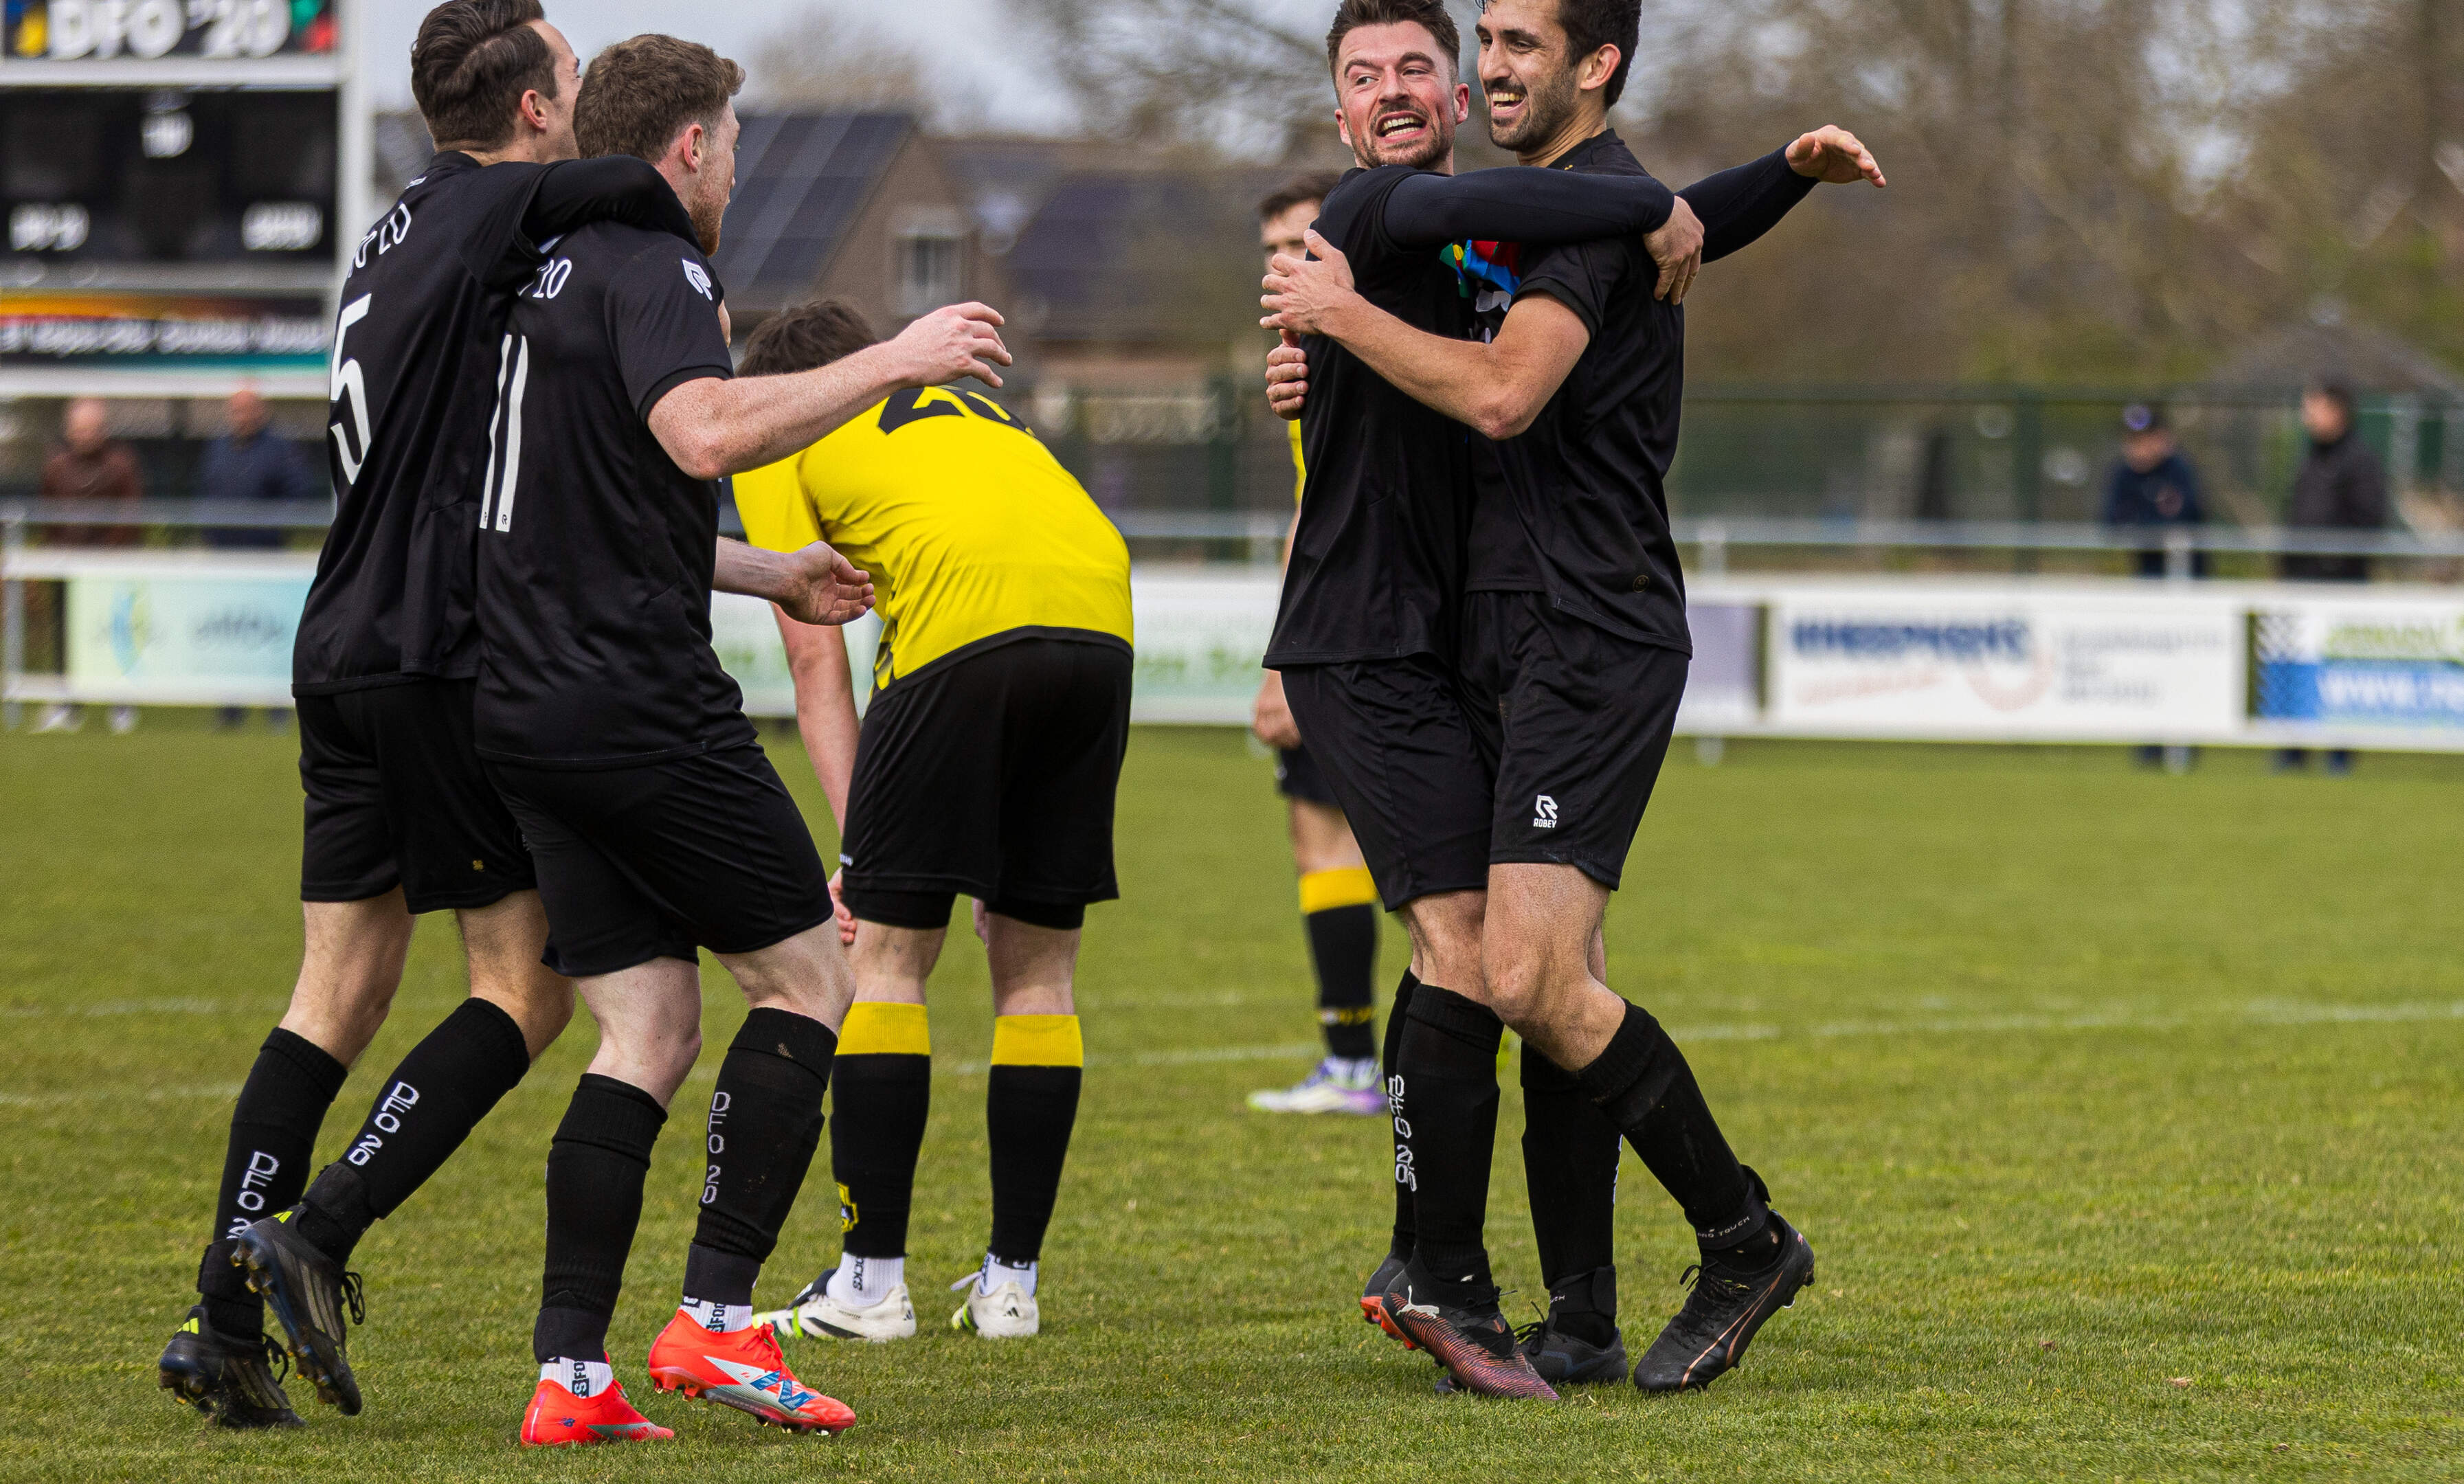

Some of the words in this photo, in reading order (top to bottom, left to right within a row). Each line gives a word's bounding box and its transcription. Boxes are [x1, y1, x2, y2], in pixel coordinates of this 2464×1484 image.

[329, 293, 372, 485] 5
[479, 333, 528, 532] 11
[1533, 818, 1557, 829] ROBEY
[374, 1081, 421, 1134] DFO
[708, 1092, 732, 1154] DFO
[348, 1134, 383, 1167] 20
[237, 1151, 280, 1211] DFO
[702, 1165, 721, 1204] 20
[1719, 1216, 1750, 1237] TOUCH
